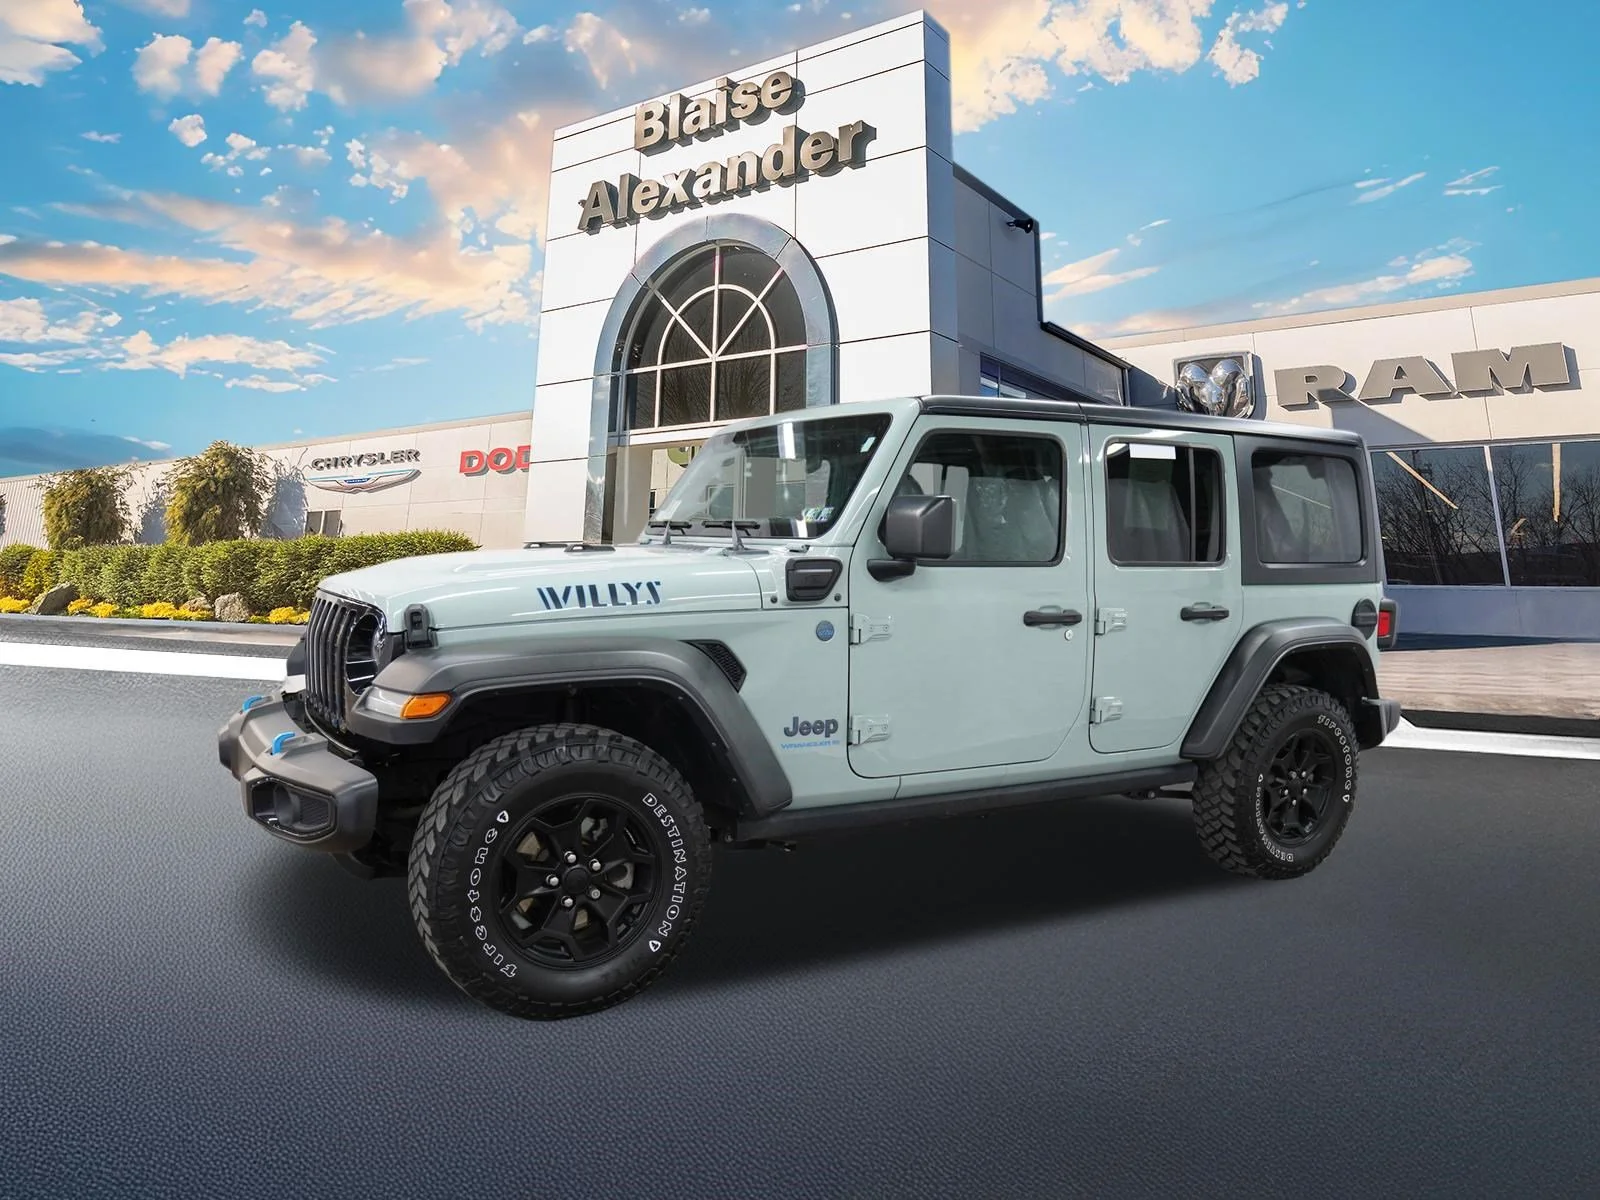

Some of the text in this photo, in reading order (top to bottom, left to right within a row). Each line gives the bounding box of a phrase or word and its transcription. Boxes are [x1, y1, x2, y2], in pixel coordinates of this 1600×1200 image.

[635, 71, 804, 156] Blaise
[578, 120, 876, 235] Alexander
[1274, 342, 1581, 411] RAM
[311, 448, 420, 471] CHRYSLER
[537, 581, 661, 610] WILLYS
[784, 716, 838, 738] Jeep
[643, 792, 687, 937] DESTINATION
